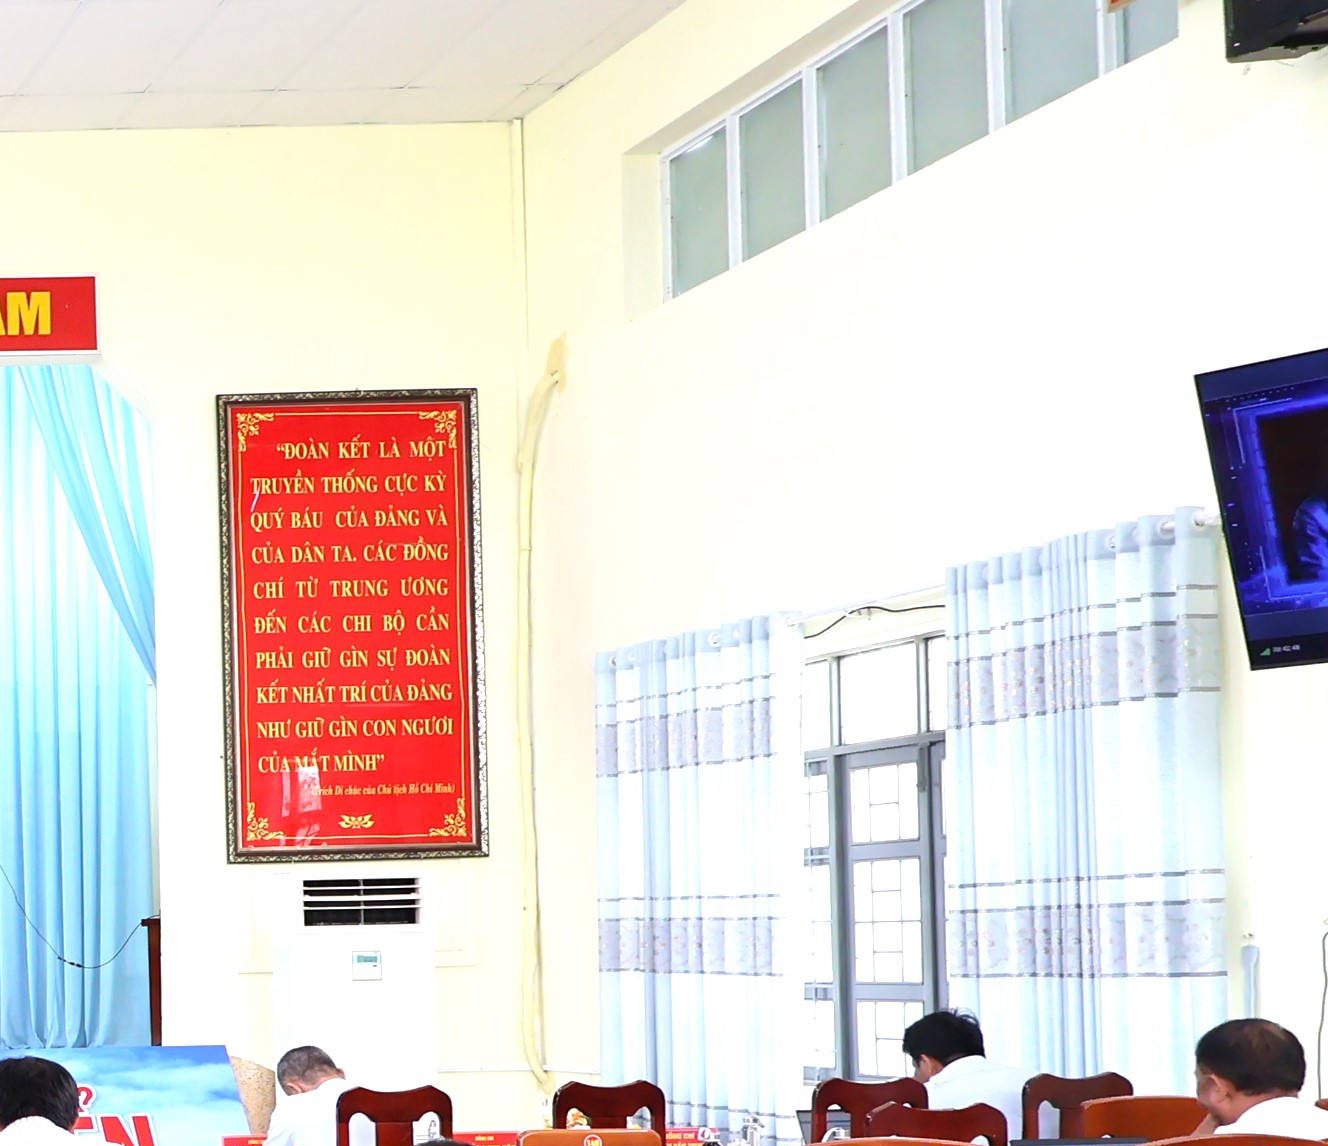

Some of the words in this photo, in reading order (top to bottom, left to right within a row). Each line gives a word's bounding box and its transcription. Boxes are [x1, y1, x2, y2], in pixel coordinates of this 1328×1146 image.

[277, 438, 329, 459] “ĐOÀN
[339, 434, 370, 458] KẾT
[379, 437, 400, 458] LÀ
[409, 436, 445, 461] MỘT
[250, 469, 314, 494] TRUYỀN
[321, 469, 378, 493] THỐNG
[385, 473, 418, 496] CỰC
[425, 470, 447, 491] KỲ
[250, 507, 284, 532] QUÝ
[291, 507, 323, 528] BÁU
[336, 506, 369, 527] CỦA
[375, 505, 419, 526] ĐẢNG
[426, 505, 448, 525] VÀ
[252, 542, 285, 564] CỦA
[292, 542, 325, 562] DÂN
[331, 546, 356, 561] TA.
[364, 540, 397, 561] CÁC
[403, 536, 448, 561] ĐỒNG
[253, 577, 284, 599] CHÍ
[296, 576, 318, 597] TỪ
[330, 580, 388, 597] TRUNG
[401, 577, 448, 596] ƯƠNG
[254, 609, 286, 633] ĐẾN
[298, 612, 331, 633] CÁC
[343, 615, 371, 632] CHI
[383, 610, 405, 635] BỘ
[417, 606, 449, 631] CẦN
[256, 646, 293, 668] PHẢI
[302, 647, 331, 667] GIỮ
[340, 646, 368, 667] GÌN
[377, 648, 397, 670] SỰ
[406, 645, 450, 666] ĐOÀN
[257, 679, 288, 703] KẾT
[292, 678, 335, 703] NHẤT
[339, 681, 366, 702] TRÍ
[370, 680, 403, 702] CỦA
[407, 679, 452, 701] ĐẢNG
[257, 719, 291, 738] NHƯ
[296, 717, 325, 737] GIỮ
[329, 716, 358, 737] GÌN
[363, 718, 397, 736] CON
[402, 716, 453, 735] NGƯƠI
[258, 751, 290, 772] CỦA
[295, 747, 330, 772] MẮT
